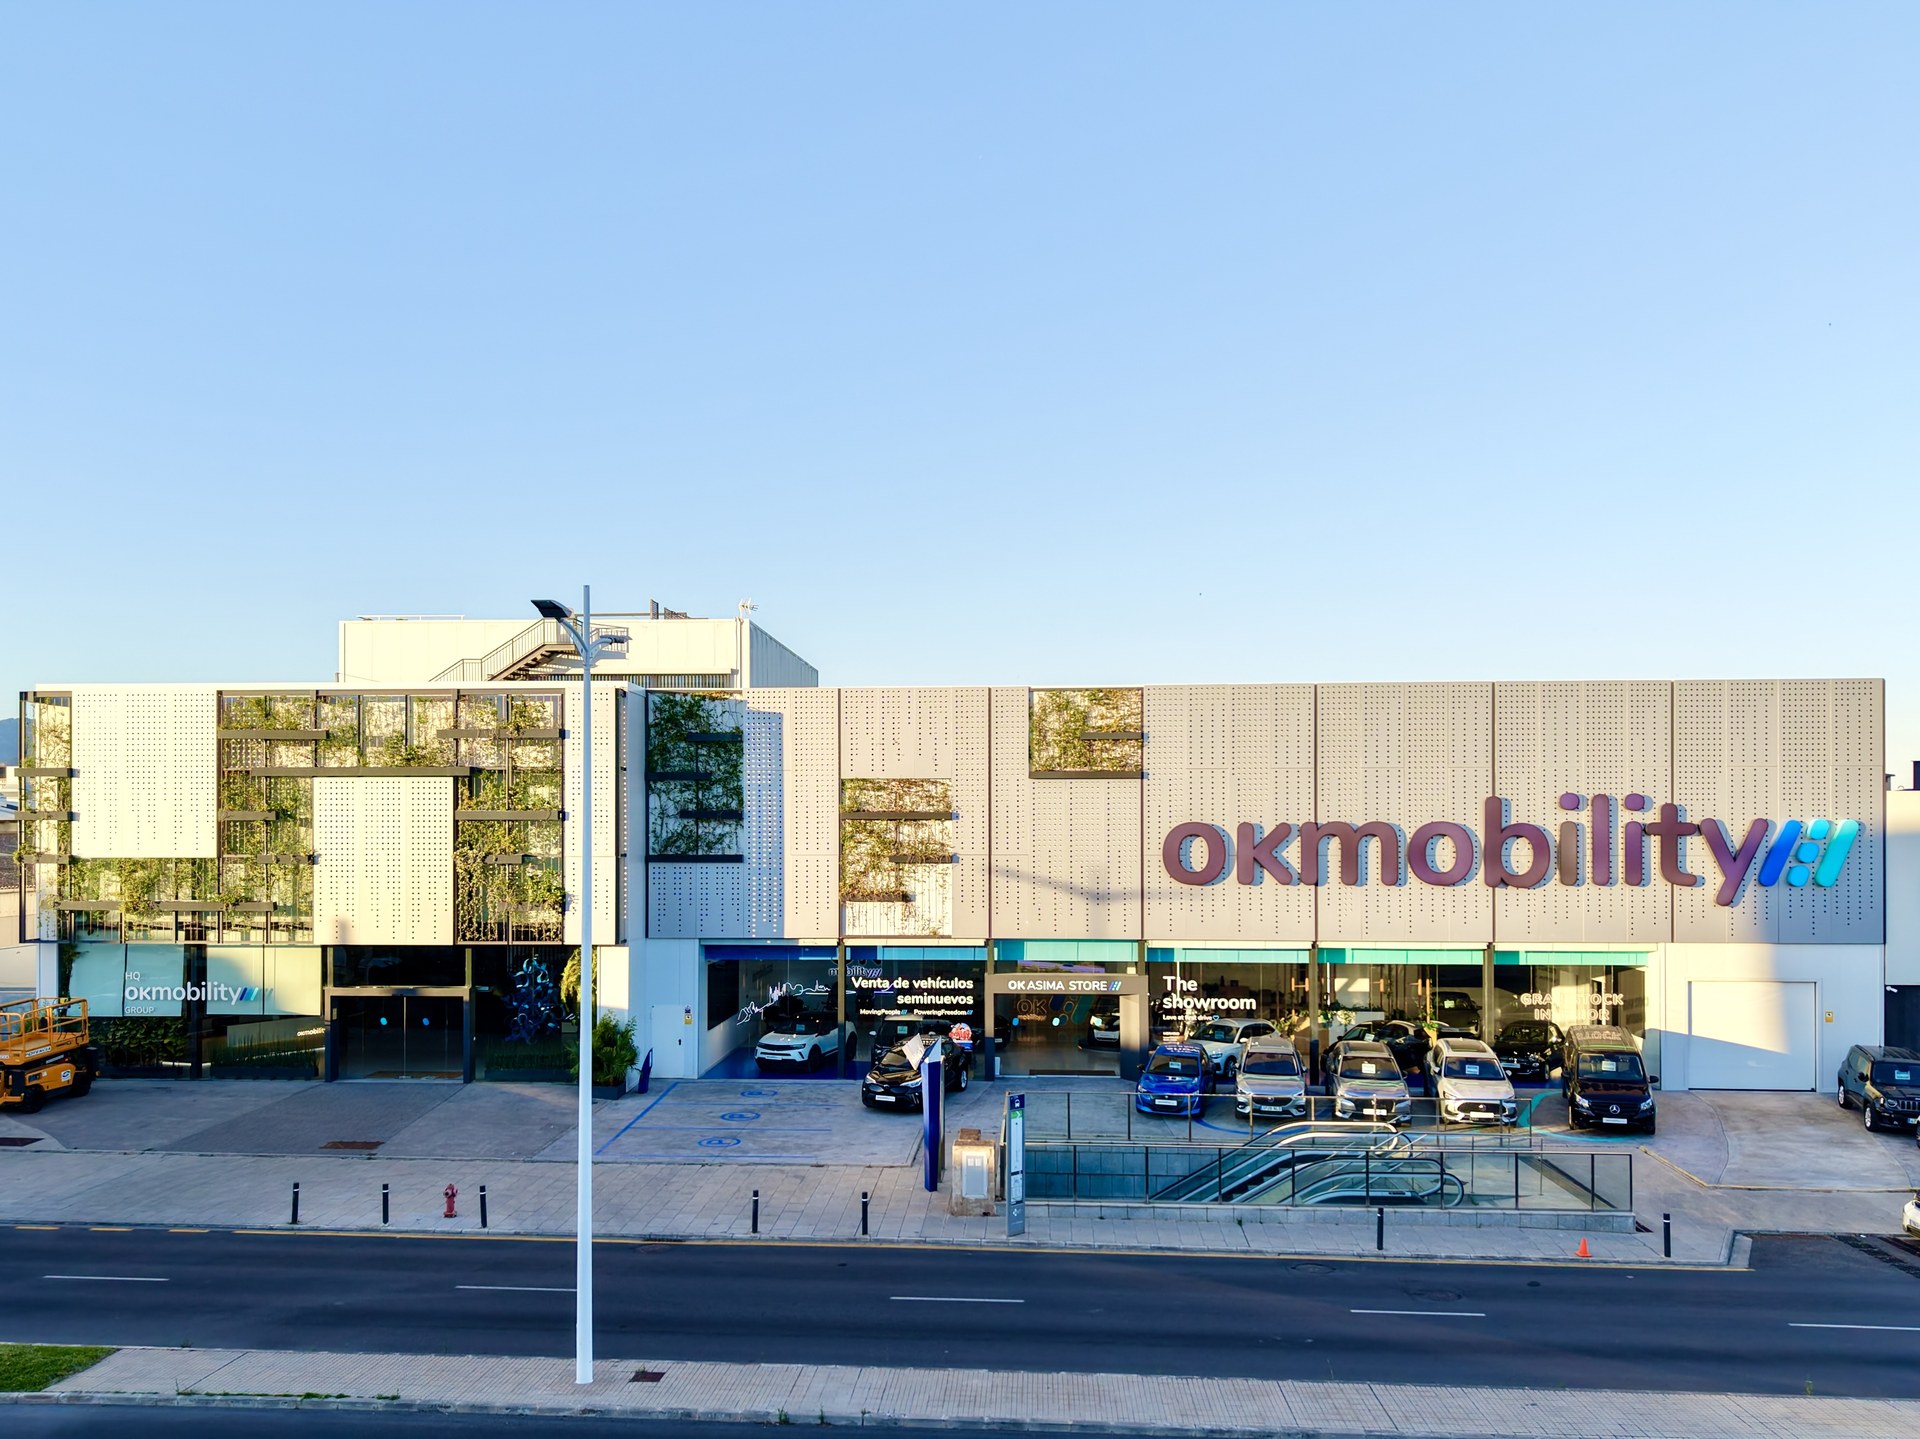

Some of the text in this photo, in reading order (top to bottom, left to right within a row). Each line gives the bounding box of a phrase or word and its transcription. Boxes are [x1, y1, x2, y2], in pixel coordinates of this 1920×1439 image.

[1162, 792, 1769, 907] okmobility
[125, 972, 141, 981] HQ
[828, 965, 870, 977] mbility
[851, 976, 974, 989] Venta de vehículos
[1008, 980, 1107, 991] OK ASIMA STORE
[1162, 976, 1198, 992] The
[125, 981, 241, 1005] okmobility
[897, 992, 974, 1005] seminuevos
[1520, 993, 1562, 1006] GRA
[1016, 999, 1048, 1014] OK
[1162, 992, 1257, 1010] showroom
[124, 1006, 155, 1014] GROUP
[859, 1008, 967, 1016] MovingPeople PoweringFreedom
[297, 1027, 326, 1037] okmobilit
